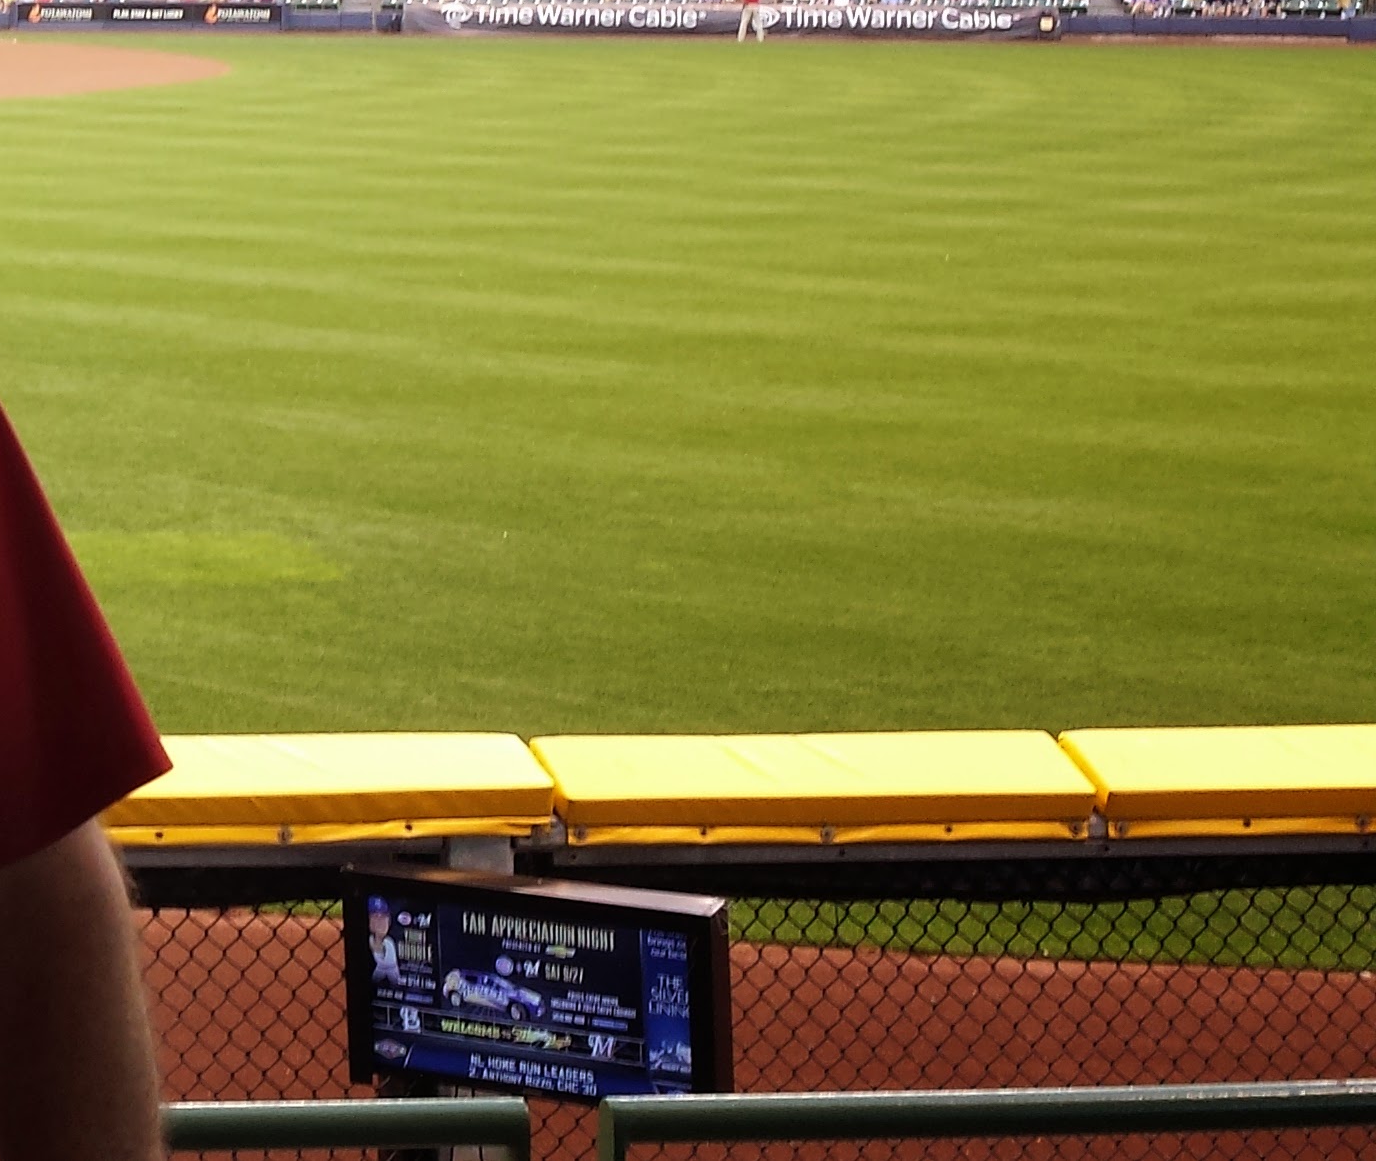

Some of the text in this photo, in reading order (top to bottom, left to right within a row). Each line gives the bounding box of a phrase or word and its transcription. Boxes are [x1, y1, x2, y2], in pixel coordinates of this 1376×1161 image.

[477, 4, 698, 28] Time Warner Cable
[781, 6, 1013, 30] Time Warner Cable
[463, 911, 615, 952] FAN APPRECIATION NIGHT
[482, 1068, 522, 1085] ANTHONY
[488, 1055, 516, 1073] HOME
[519, 1060, 540, 1076] RUN
[544, 1063, 594, 1084] LEADERS
